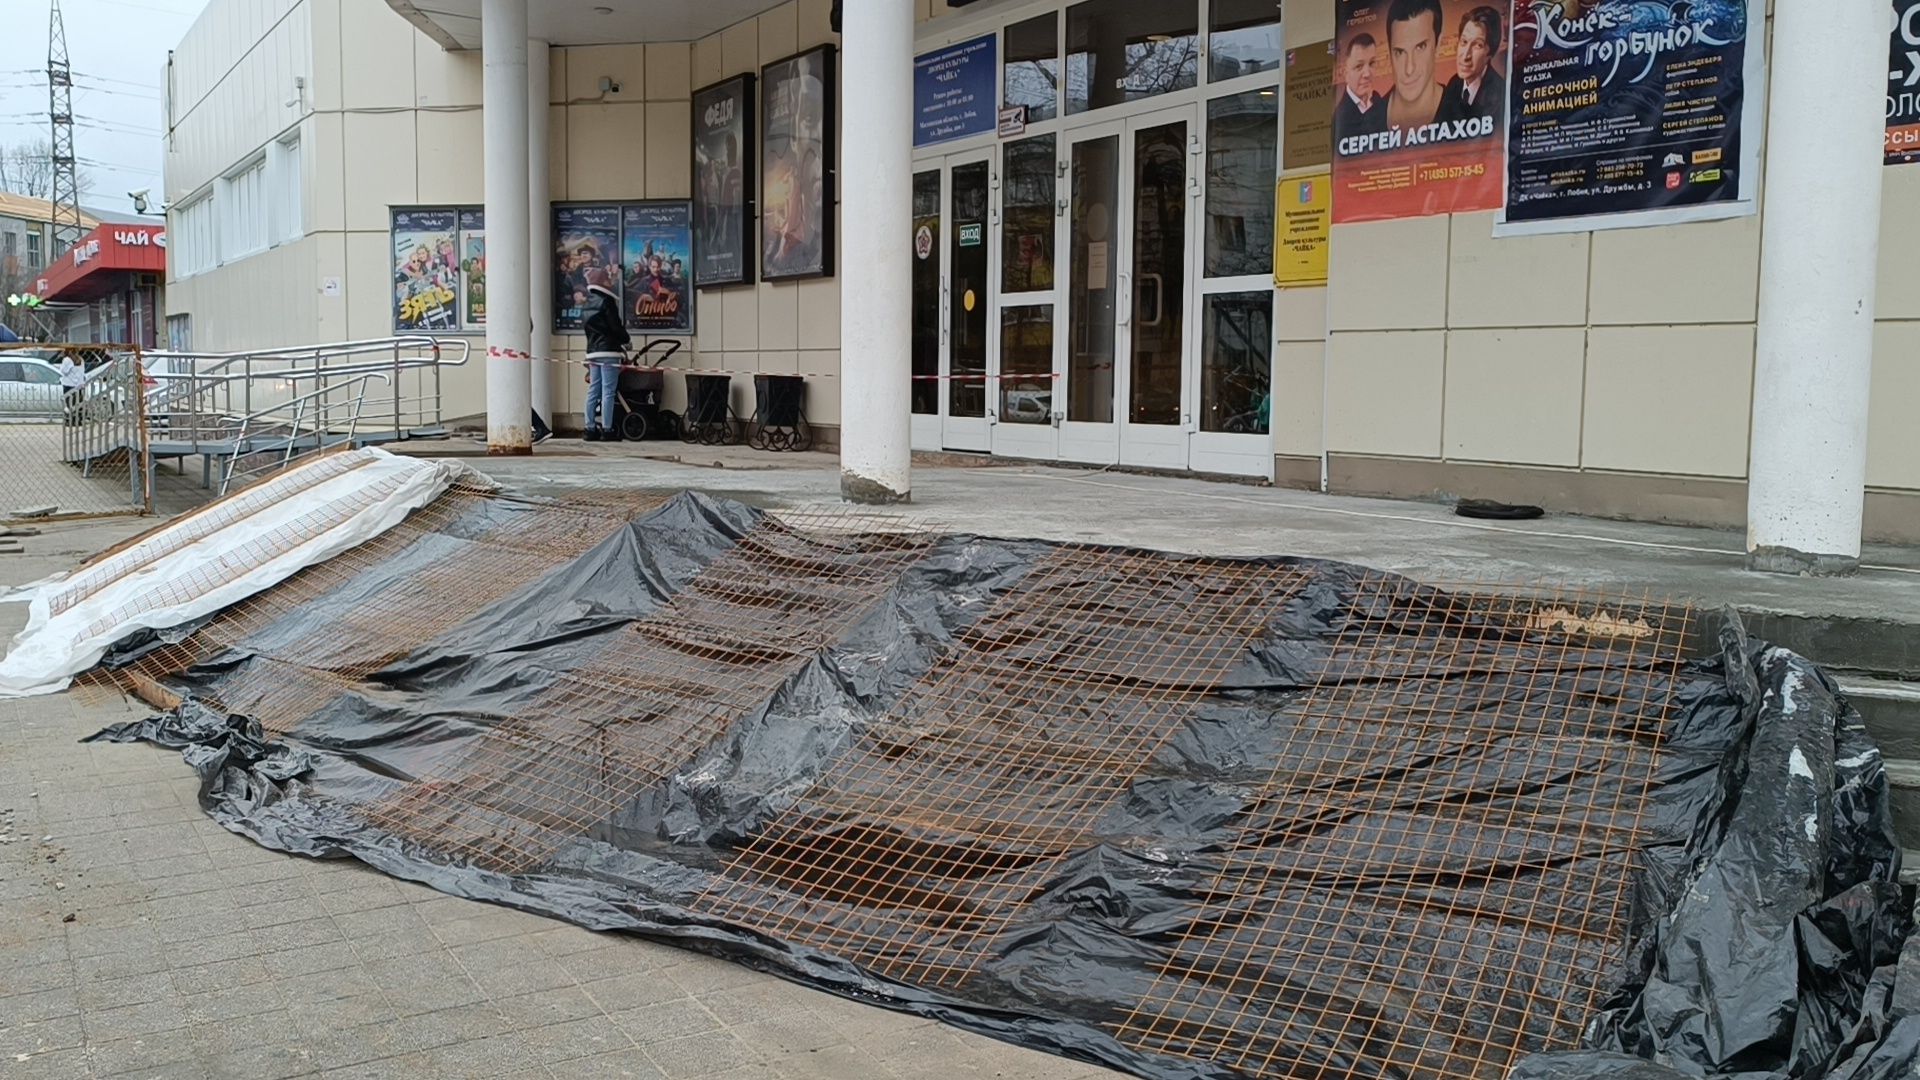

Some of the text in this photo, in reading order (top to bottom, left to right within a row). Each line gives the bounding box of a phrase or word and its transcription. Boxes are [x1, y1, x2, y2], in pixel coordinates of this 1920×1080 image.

[1523, 56, 1580, 73] МУЗЫКАЛЬНАЯ
[1523, 72, 1552, 84] СКАЗКА
[1523, 75, 1597, 99] С ПЕСОЧНОЙ
[704, 97, 734, 127] ФЕДЯ
[1523, 90, 1598, 115] АНИМАЦИЕЙ
[1339, 124, 1402, 155] СЕРГЕЙ
[1405, 115, 1494, 147] АСТАХОВ
[114, 230, 149, 246] ЧАЙ
[961, 228, 979, 240] ВХОД
